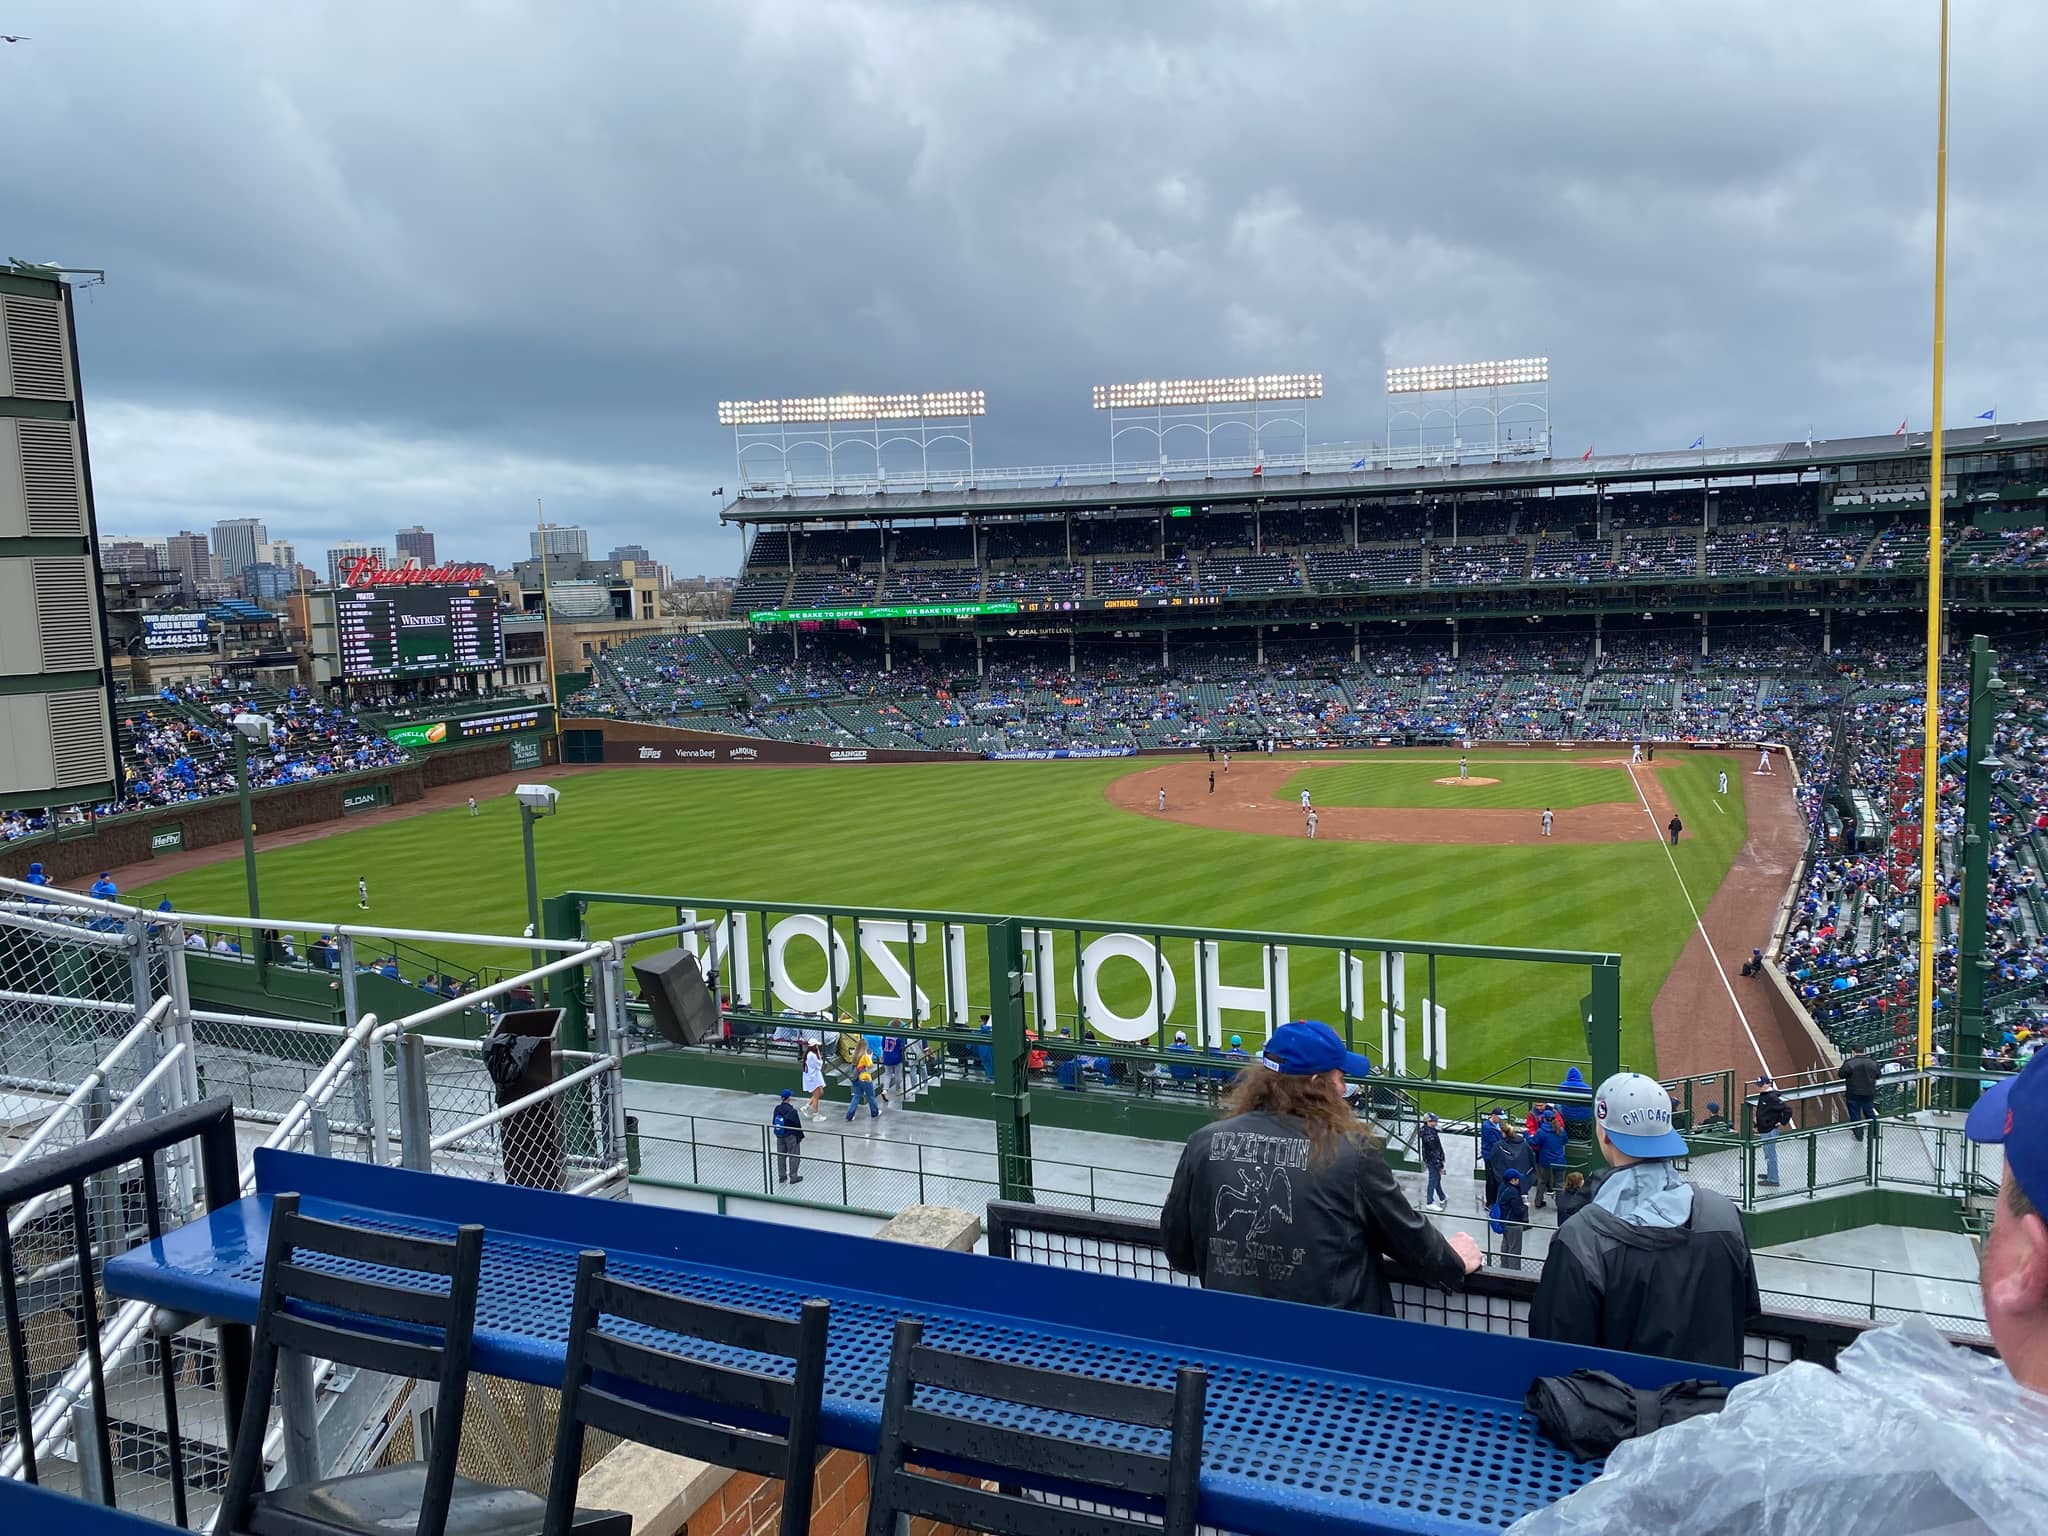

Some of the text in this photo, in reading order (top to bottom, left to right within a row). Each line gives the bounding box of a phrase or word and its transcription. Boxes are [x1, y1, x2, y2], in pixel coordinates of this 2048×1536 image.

[339, 555, 484, 589] Budweiser
[1104, 599, 1138, 608] CONTRERAS
[144, 634, 208, 645] 844-465-3515
[675, 748, 716, 759] Vienna Beef
[729, 747, 758, 757] MARQUEE
[829, 750, 867, 758] GRAINGER
[994, 751, 1046, 760] Reynolds Wrap
[1068, 750, 1100, 758] Reynolds
[344, 793, 375, 807] SLOAN
[153, 833, 179, 848] Hefty
[1622, 1109, 1671, 1126] CHICAGO
